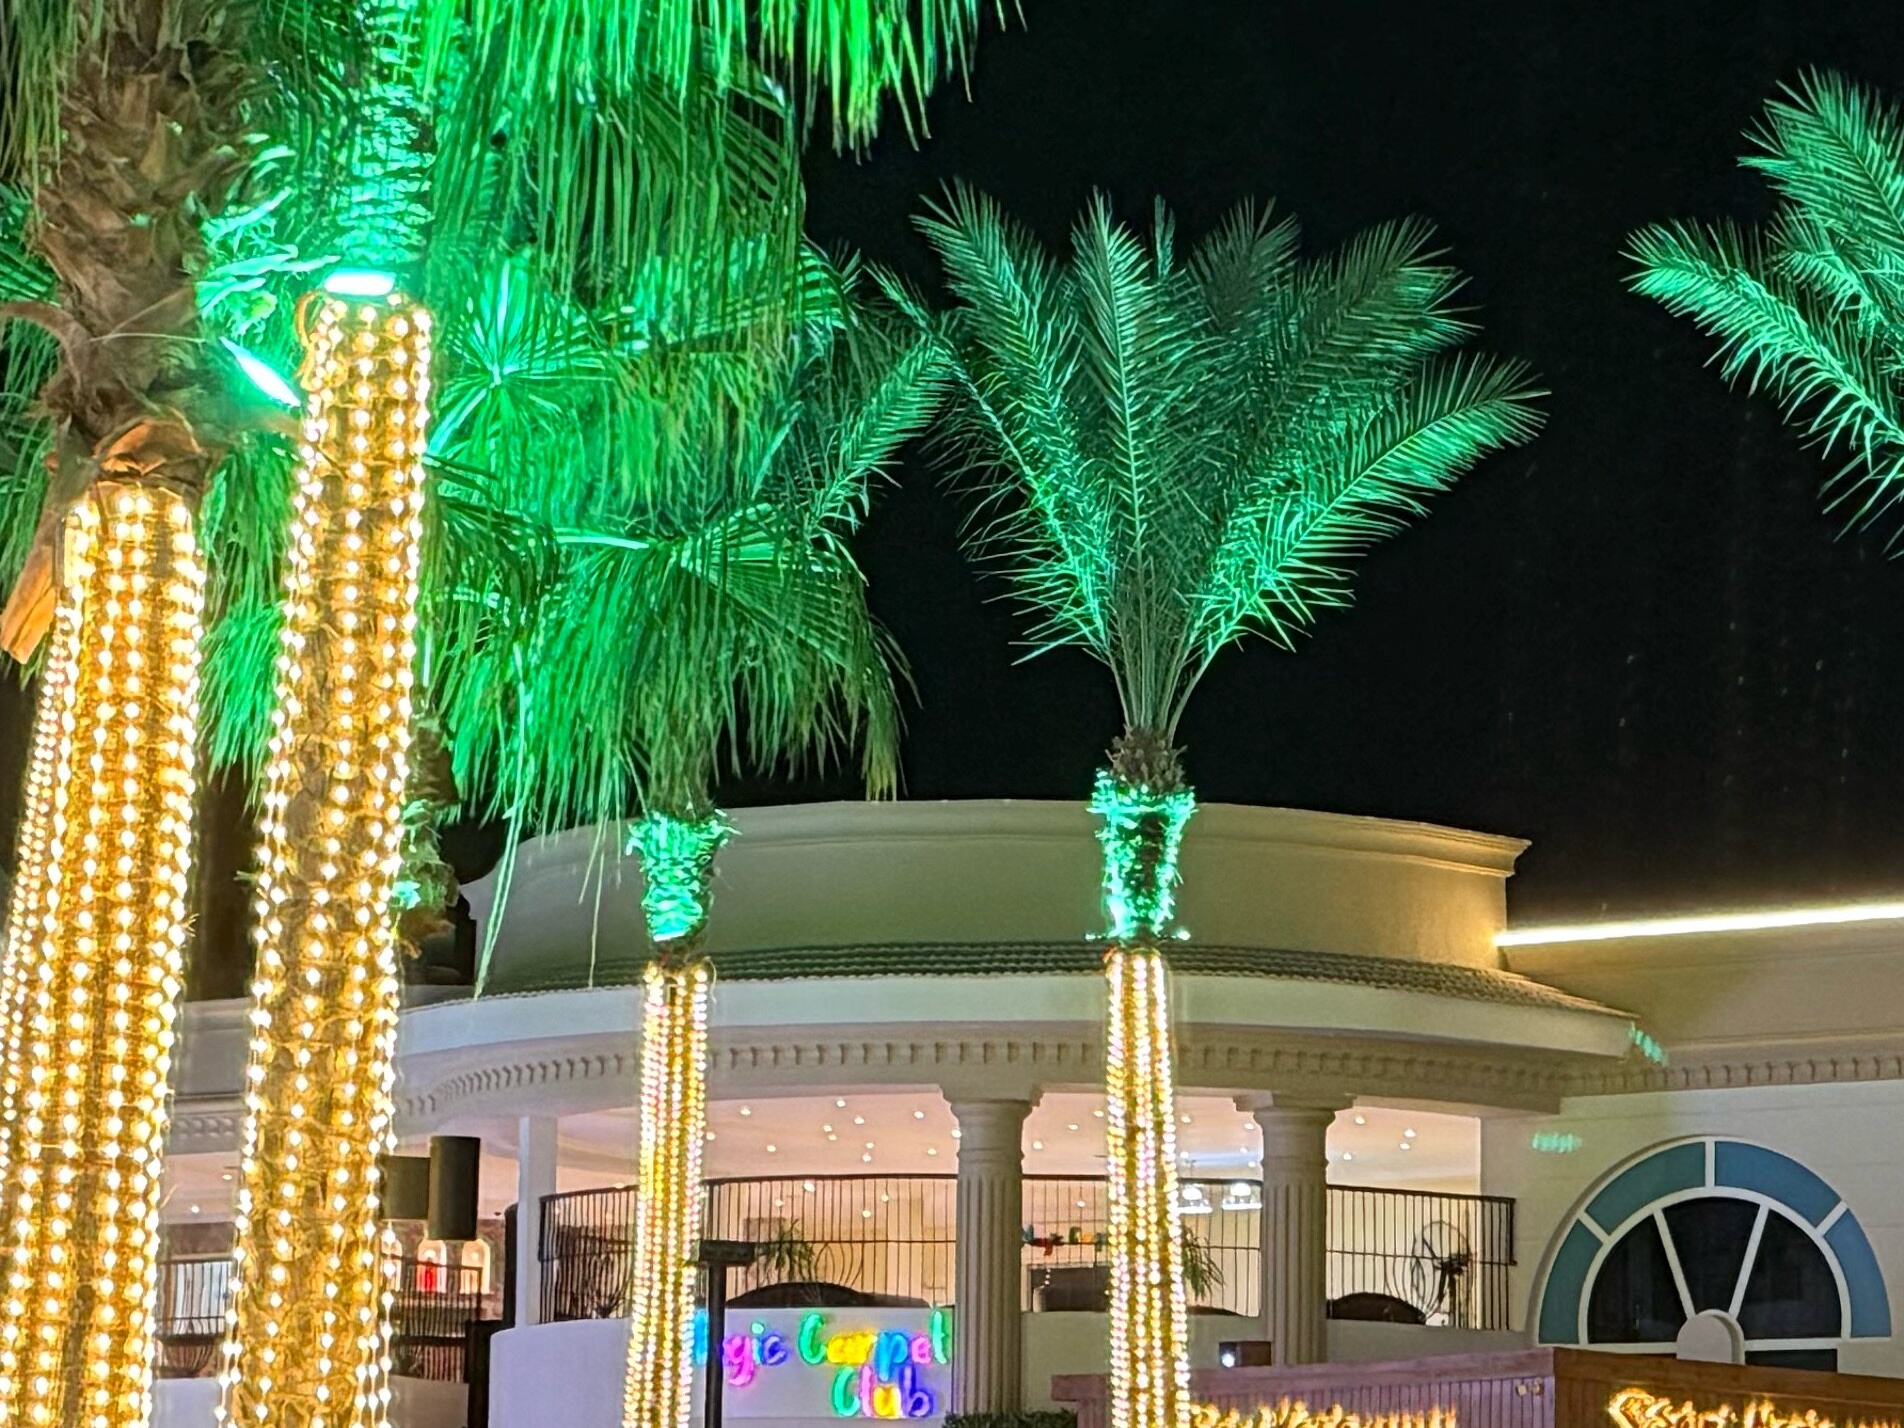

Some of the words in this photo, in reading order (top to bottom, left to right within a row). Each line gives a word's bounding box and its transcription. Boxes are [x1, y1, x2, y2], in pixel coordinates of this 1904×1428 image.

[693, 1310, 789, 1387] gic
[798, 1310, 950, 1383] Carpet
[831, 1364, 934, 1418] Club
